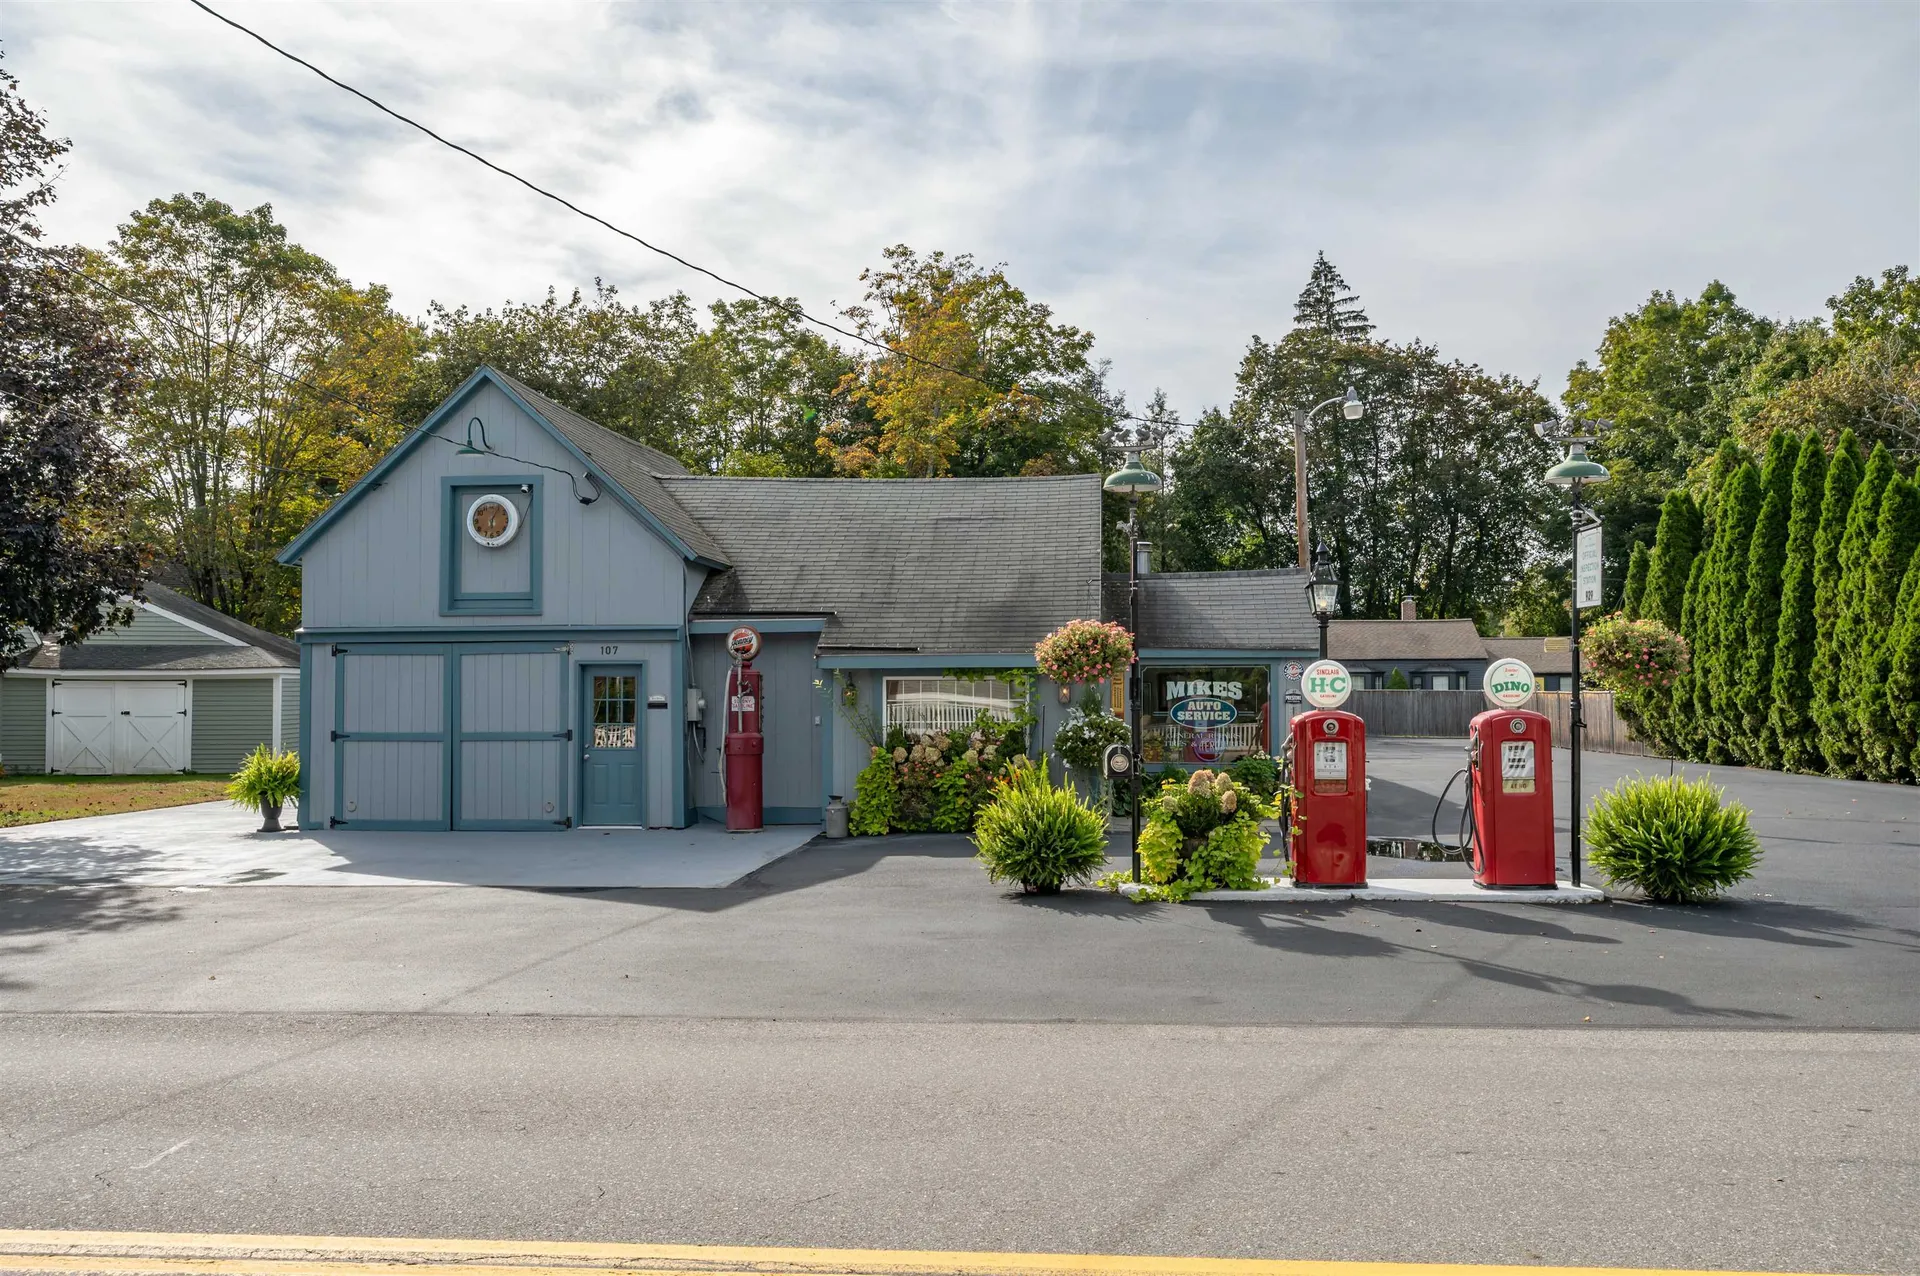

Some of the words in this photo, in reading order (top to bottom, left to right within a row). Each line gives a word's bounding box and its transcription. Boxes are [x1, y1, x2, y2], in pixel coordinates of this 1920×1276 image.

[1582, 575, 1596, 585] STATION
[601, 646, 618, 655] 107
[1166, 681, 1243, 701] MIKES
[1492, 681, 1530, 694] DINO
[1187, 701, 1221, 710] AUTO
[1177, 711, 1230, 721] SERVICE
